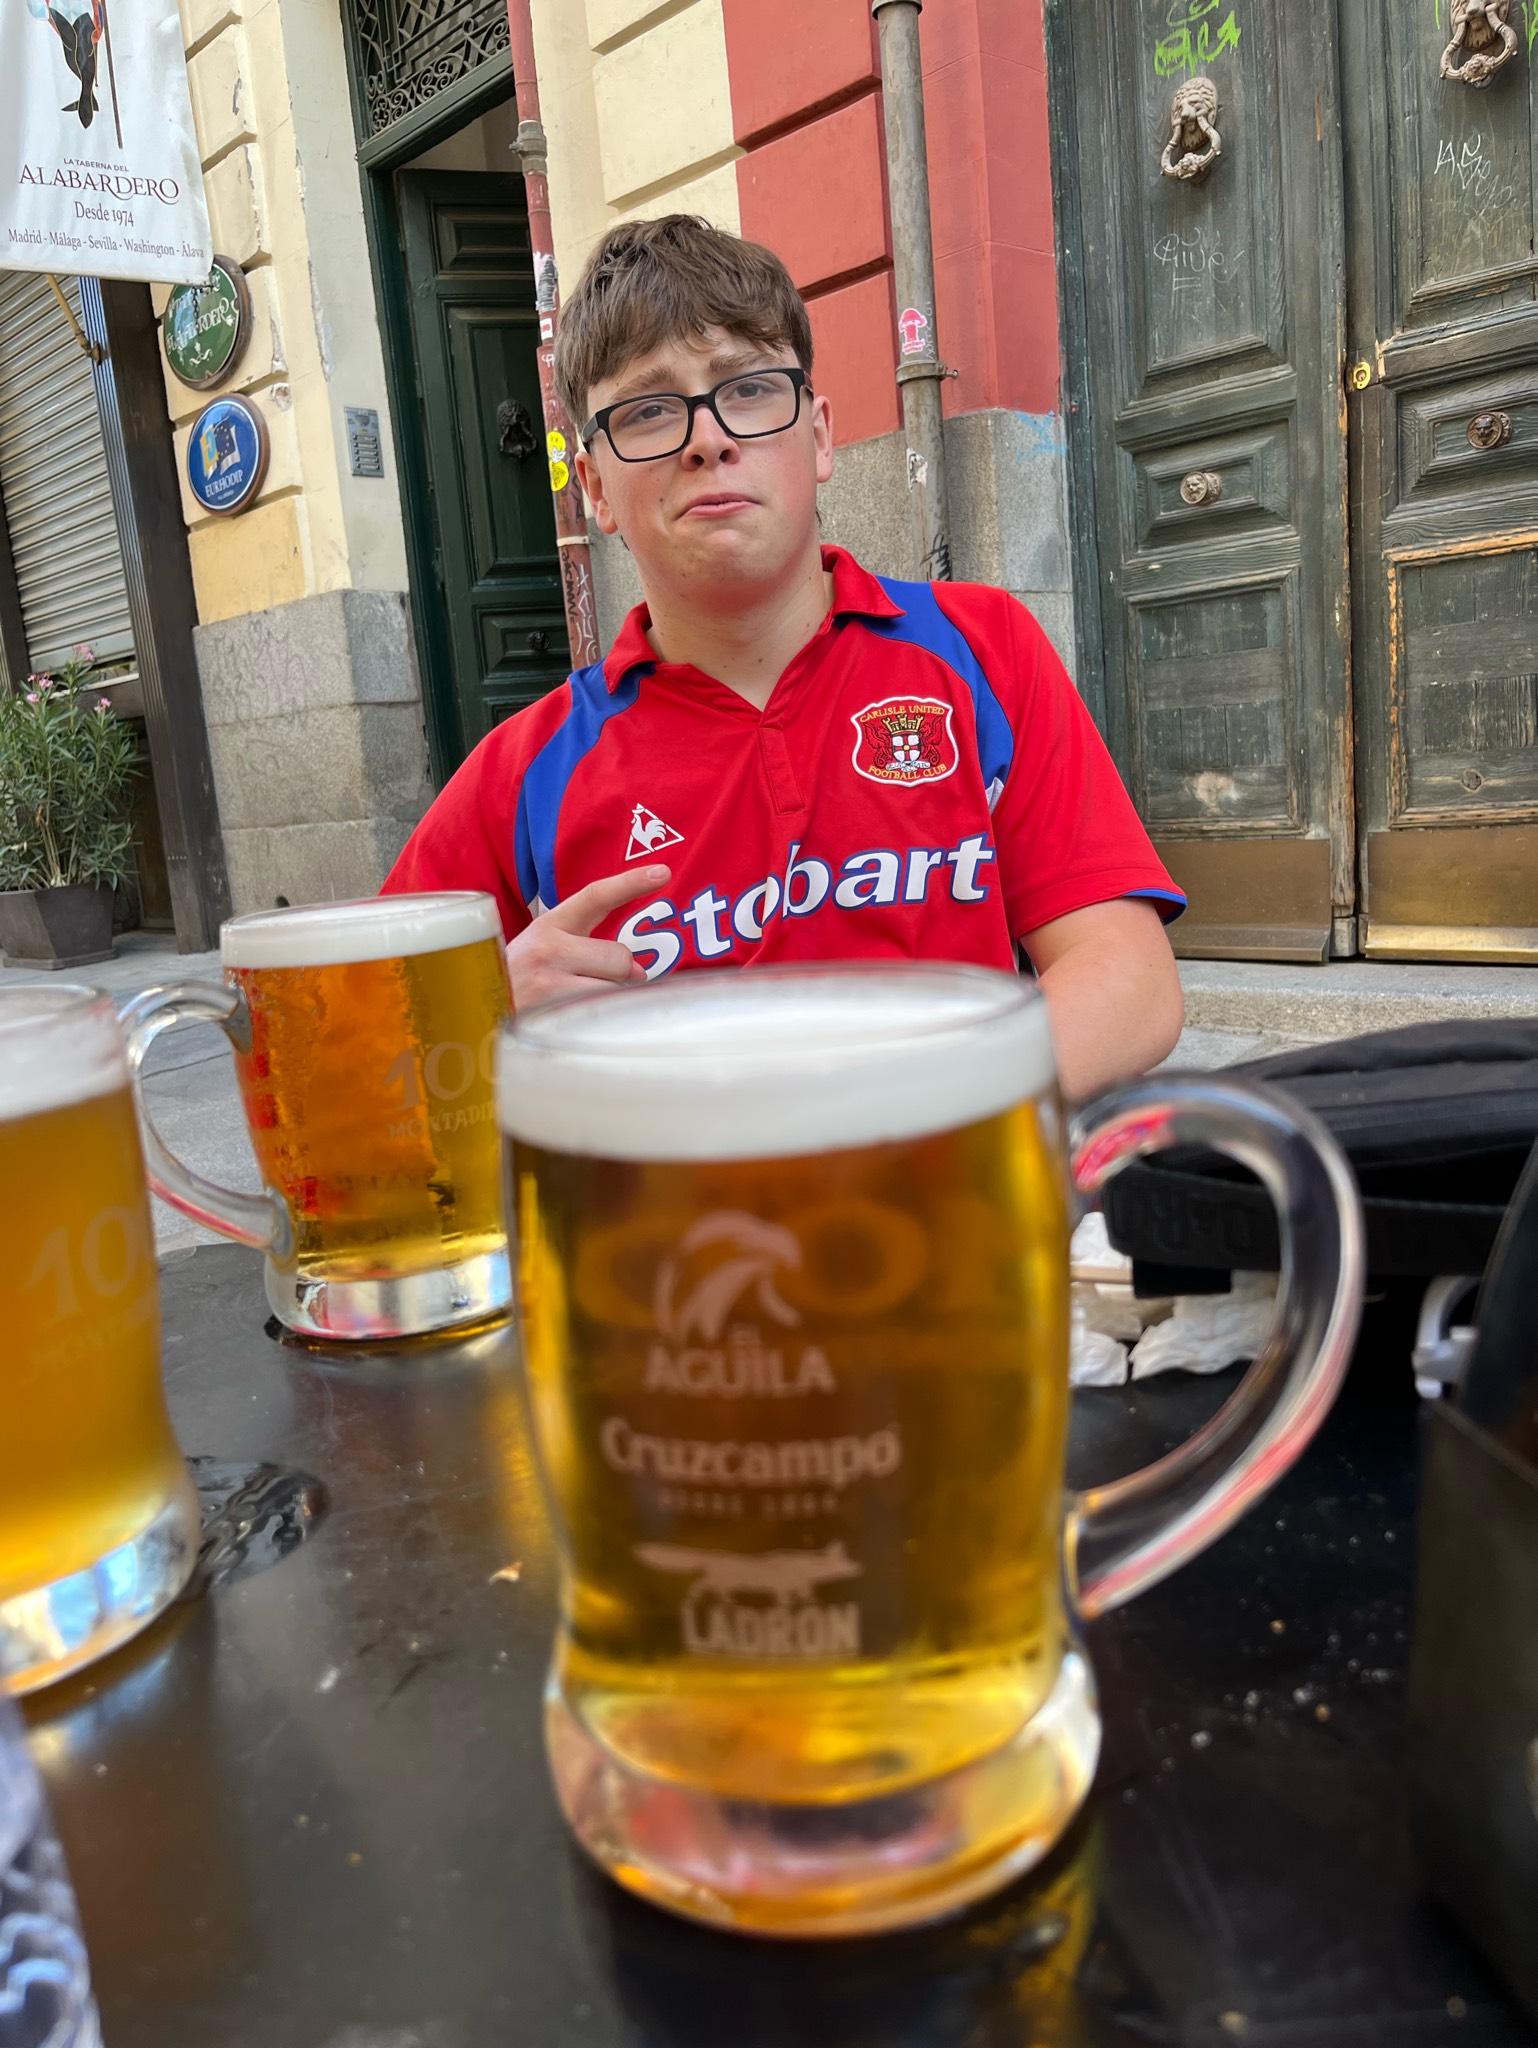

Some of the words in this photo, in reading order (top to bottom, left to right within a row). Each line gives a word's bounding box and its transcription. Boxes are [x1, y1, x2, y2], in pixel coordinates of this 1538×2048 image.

[63, 157, 74, 165] LA
[74, 159, 112, 171] TABERNA
[113, 164, 130, 173] DEL
[18, 163, 180, 206] ALABARDERO
[74, 200, 110, 222] Desde
[111, 208, 135, 228] 1974
[8, 228, 42, 244] Madrid
[49, 231, 82, 252] Málaga
[88, 234, 118, 251] Sevilla
[123, 237, 175, 259] Washington
[181, 241, 206, 259] Álava
[860, 705, 906, 723] CARLISLE
[909, 705, 945, 716] UNITED
[868, 765, 921, 780] FOOTBALL
[923, 763, 947, 777] CLUB
[615, 832, 994, 982] Stobart
[602, 1418, 900, 1492] Cruzcampo
